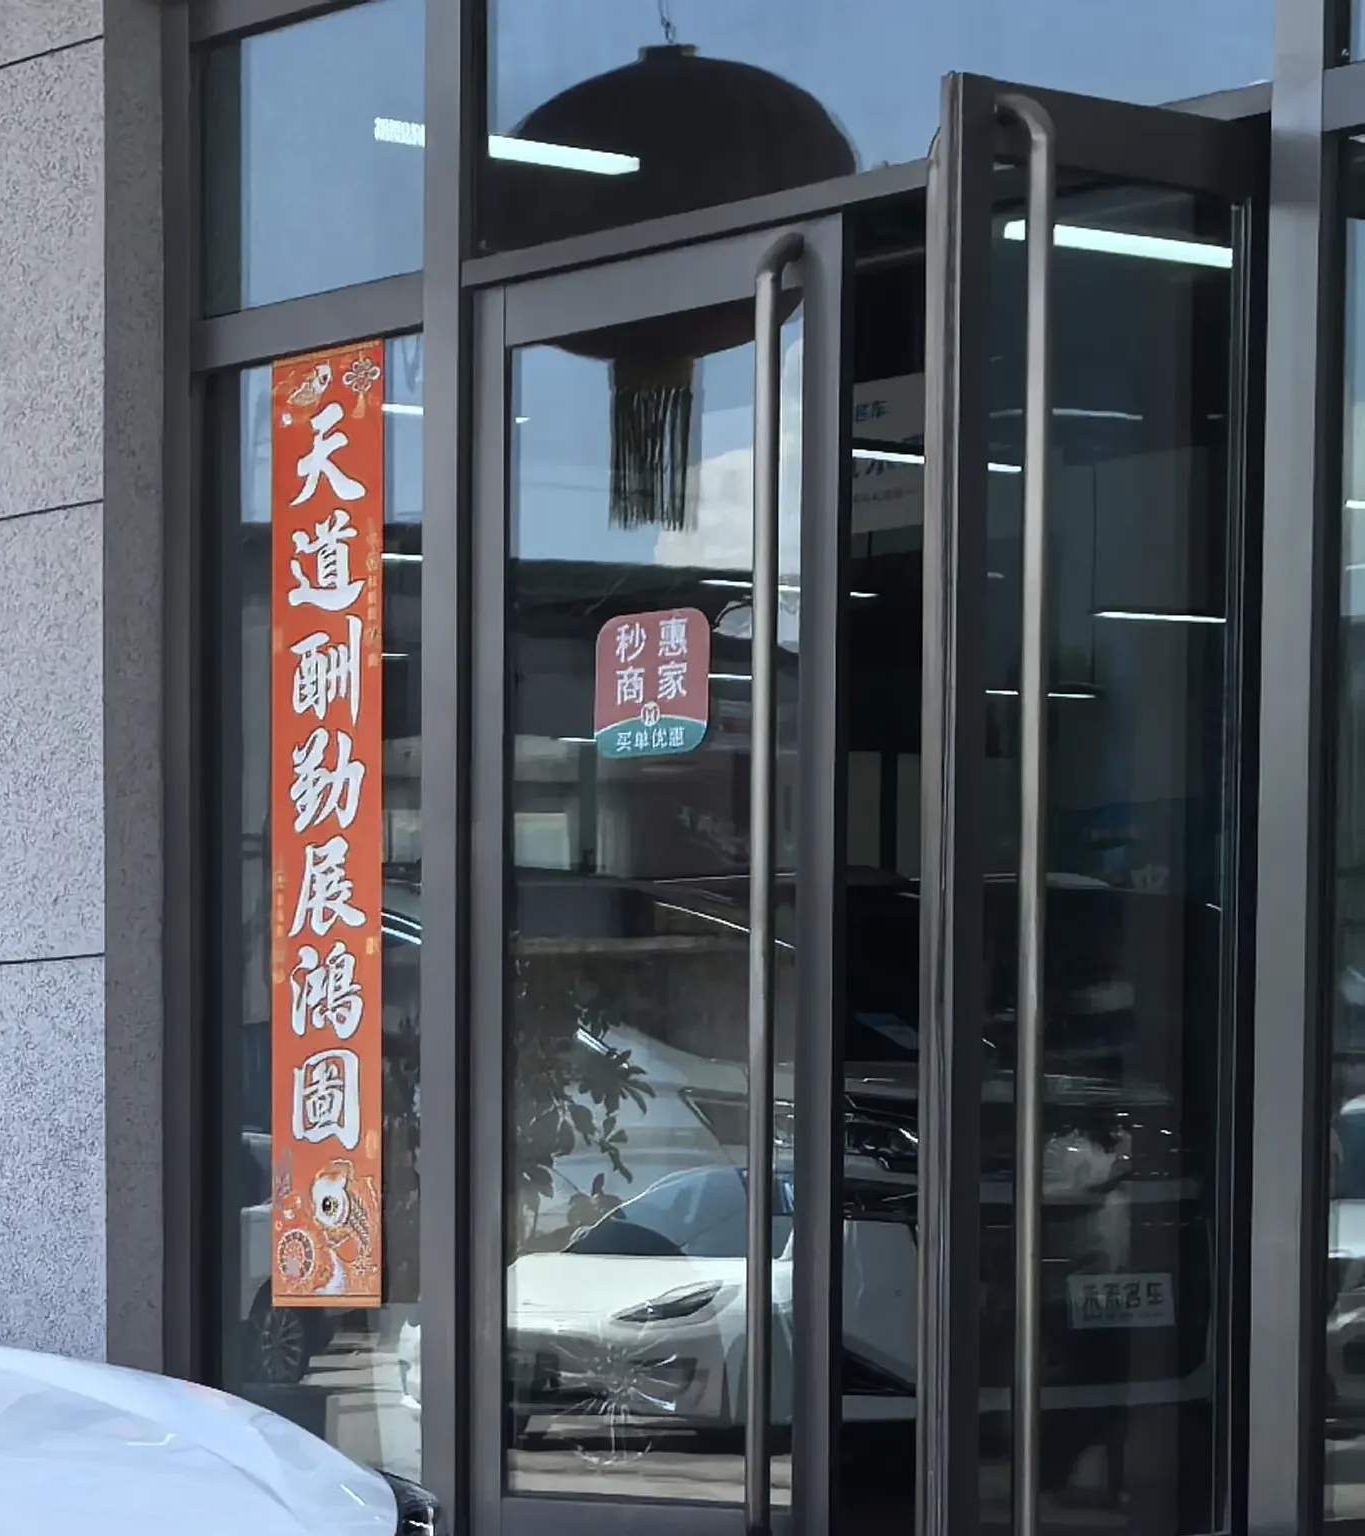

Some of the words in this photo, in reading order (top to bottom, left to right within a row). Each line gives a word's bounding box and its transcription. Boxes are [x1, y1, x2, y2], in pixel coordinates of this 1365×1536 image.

[616, 617, 688, 663] 秒惠
[615, 661, 688, 705] 商家
[617, 726, 685, 752] 买单优惠
